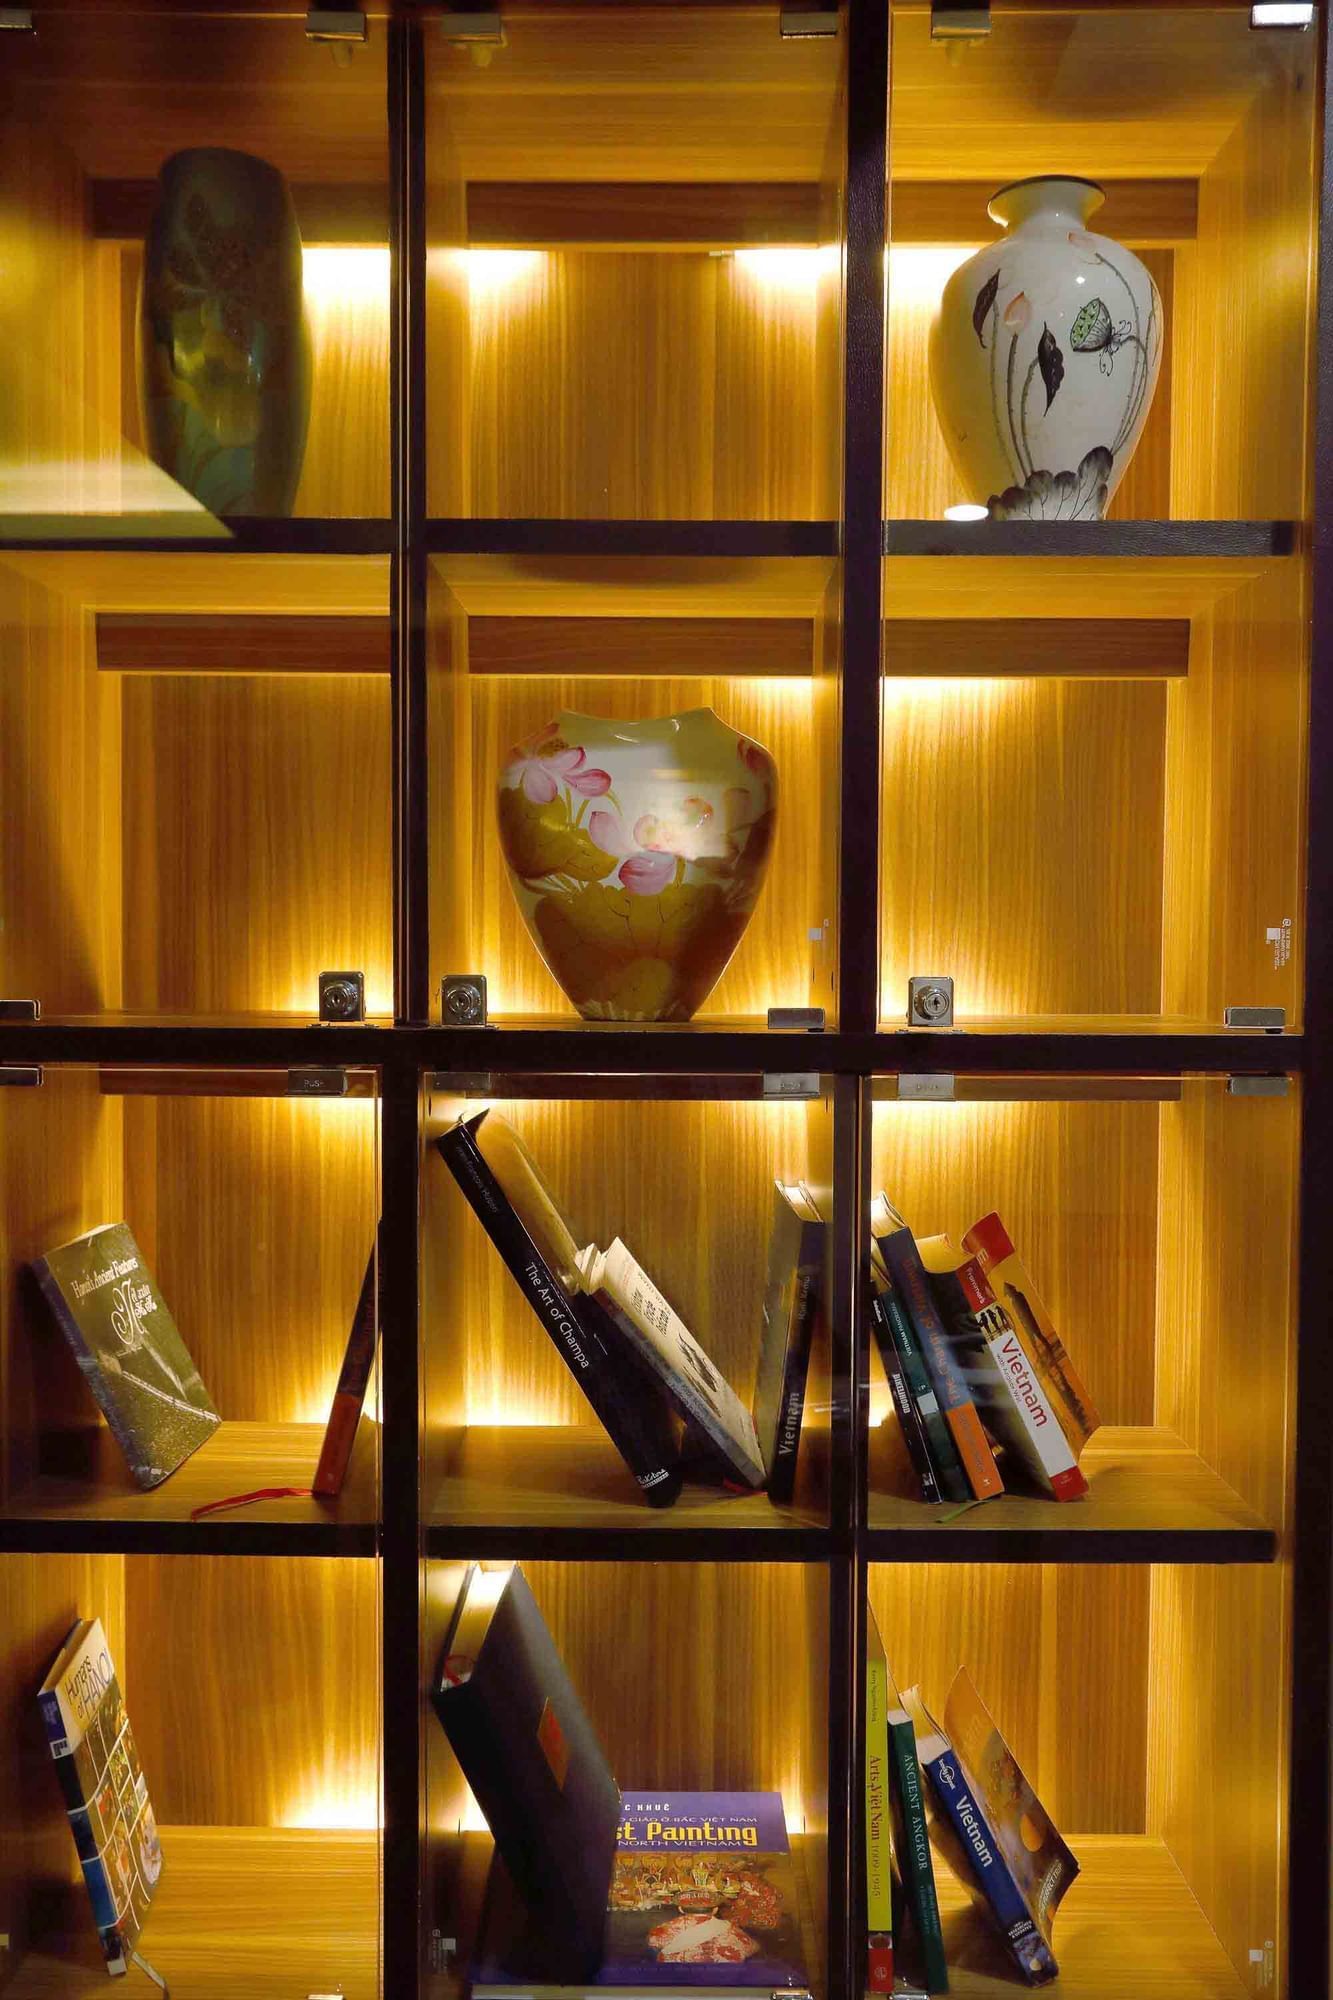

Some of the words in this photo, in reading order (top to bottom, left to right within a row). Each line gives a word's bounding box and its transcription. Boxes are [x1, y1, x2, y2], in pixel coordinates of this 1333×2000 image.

[524, 1261, 542, 1288] The
[538, 1286, 555, 1309] Art
[550, 1307, 564, 1322] of
[559, 1321, 590, 1371] Champa
[1001, 1337, 1048, 1427] Vietnam
[778, 1391, 801, 1457] Vietnam
[869, 1755, 882, 1780] Arts
[903, 1754, 921, 1811] ANCIENT
[646, 1821, 758, 1846] Painting
[870, 1815, 882, 1841] Nam
[911, 1815, 929, 1871] ANGKOR
[954, 1794, 994, 1868] Vietnam
